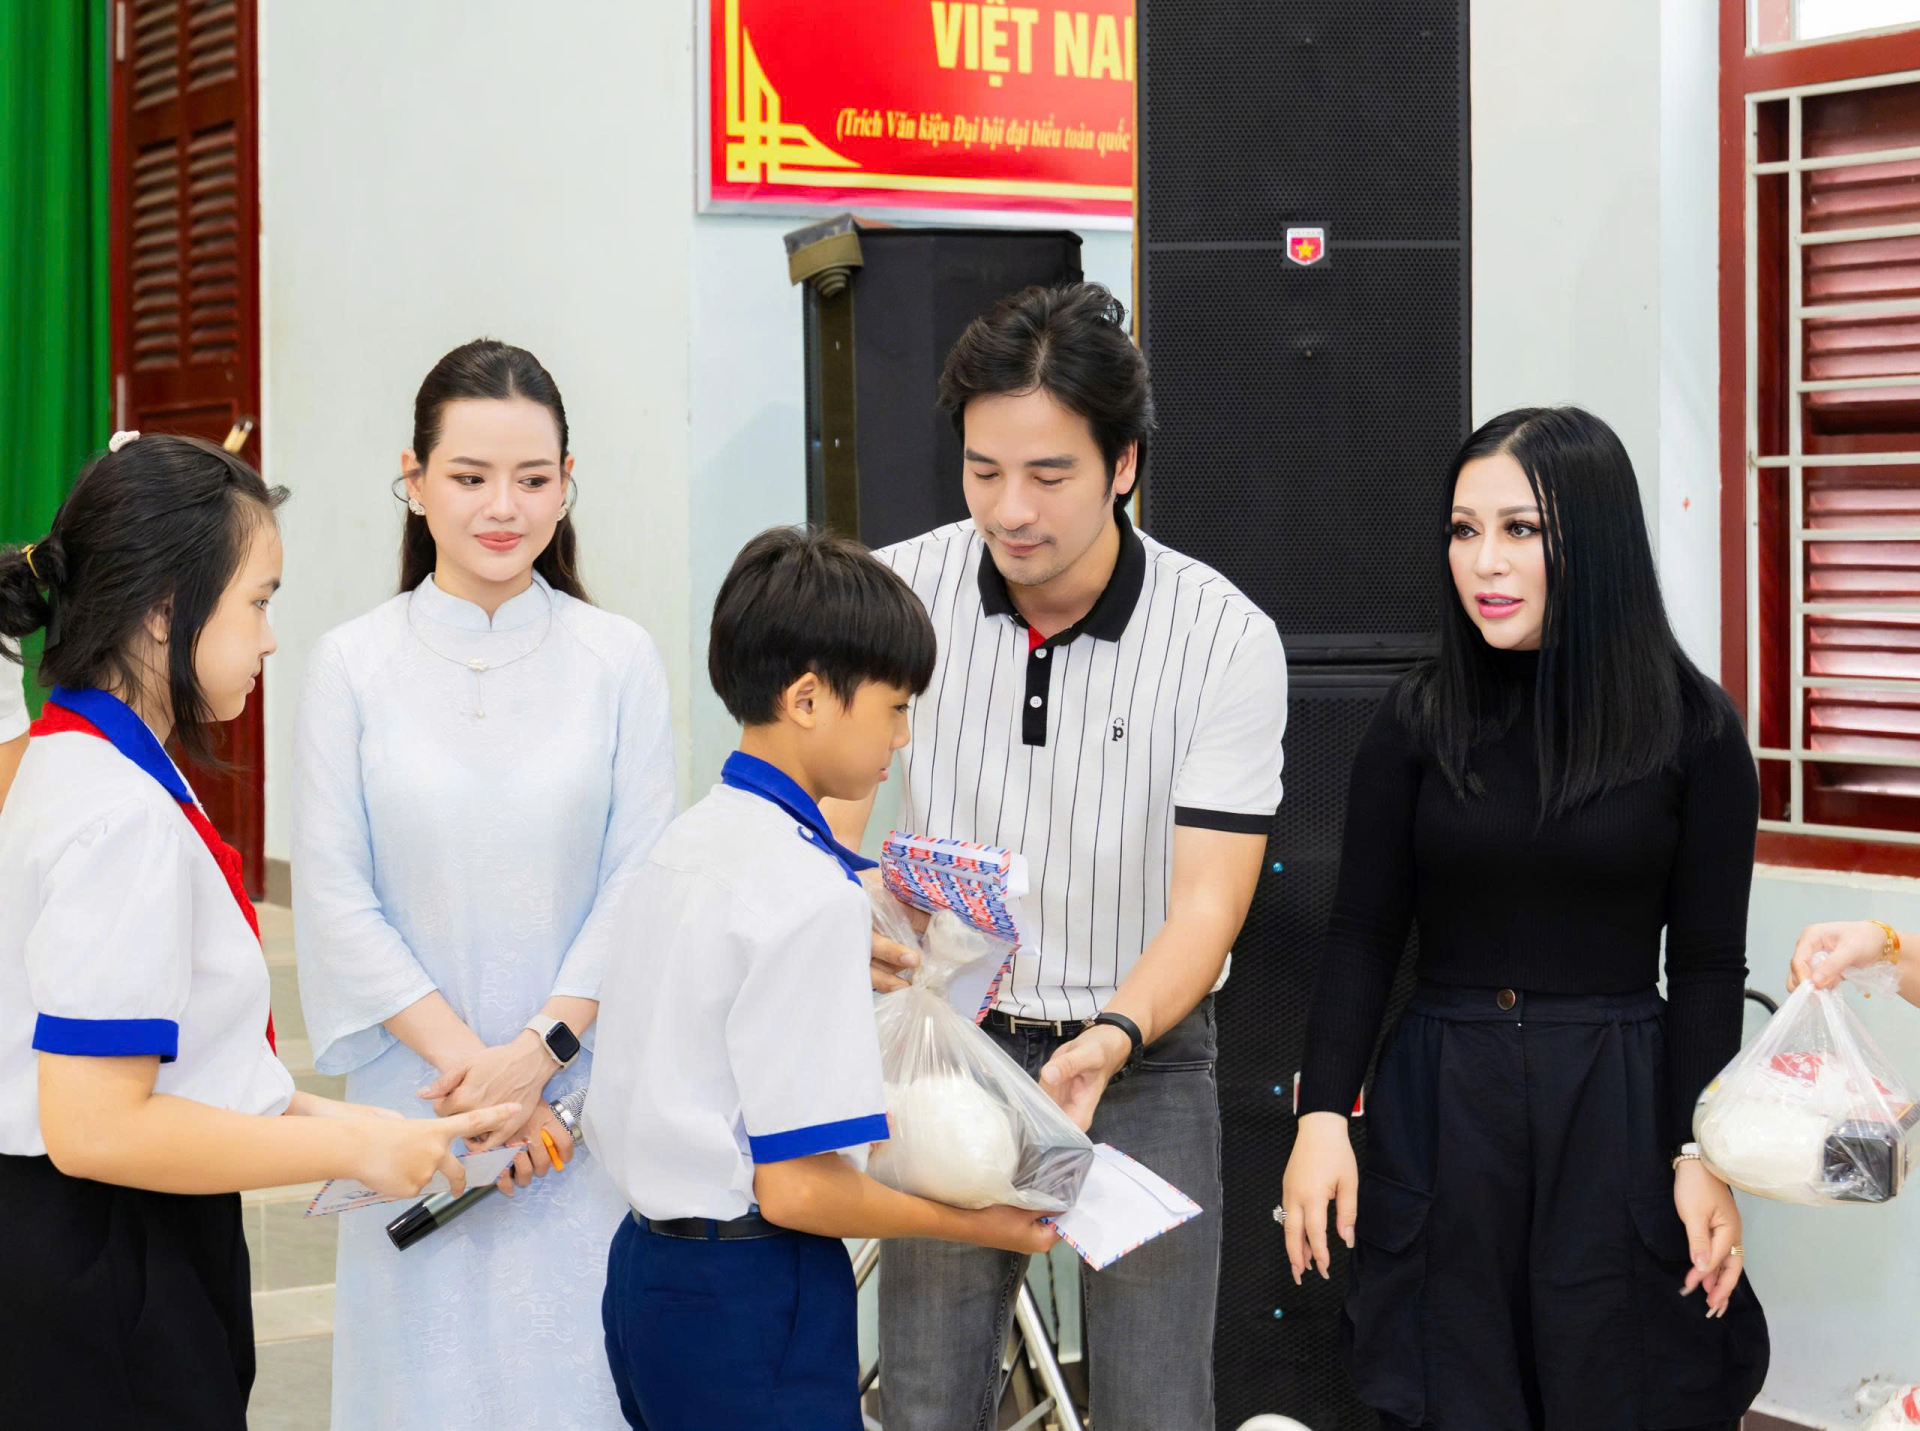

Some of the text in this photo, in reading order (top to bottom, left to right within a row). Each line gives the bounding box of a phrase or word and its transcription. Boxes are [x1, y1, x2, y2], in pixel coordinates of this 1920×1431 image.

[931, 0, 1039, 88] VIỆT
[836, 107, 1131, 157] (Trích Văn kiện Đại hội đại biểu toàn quốc
